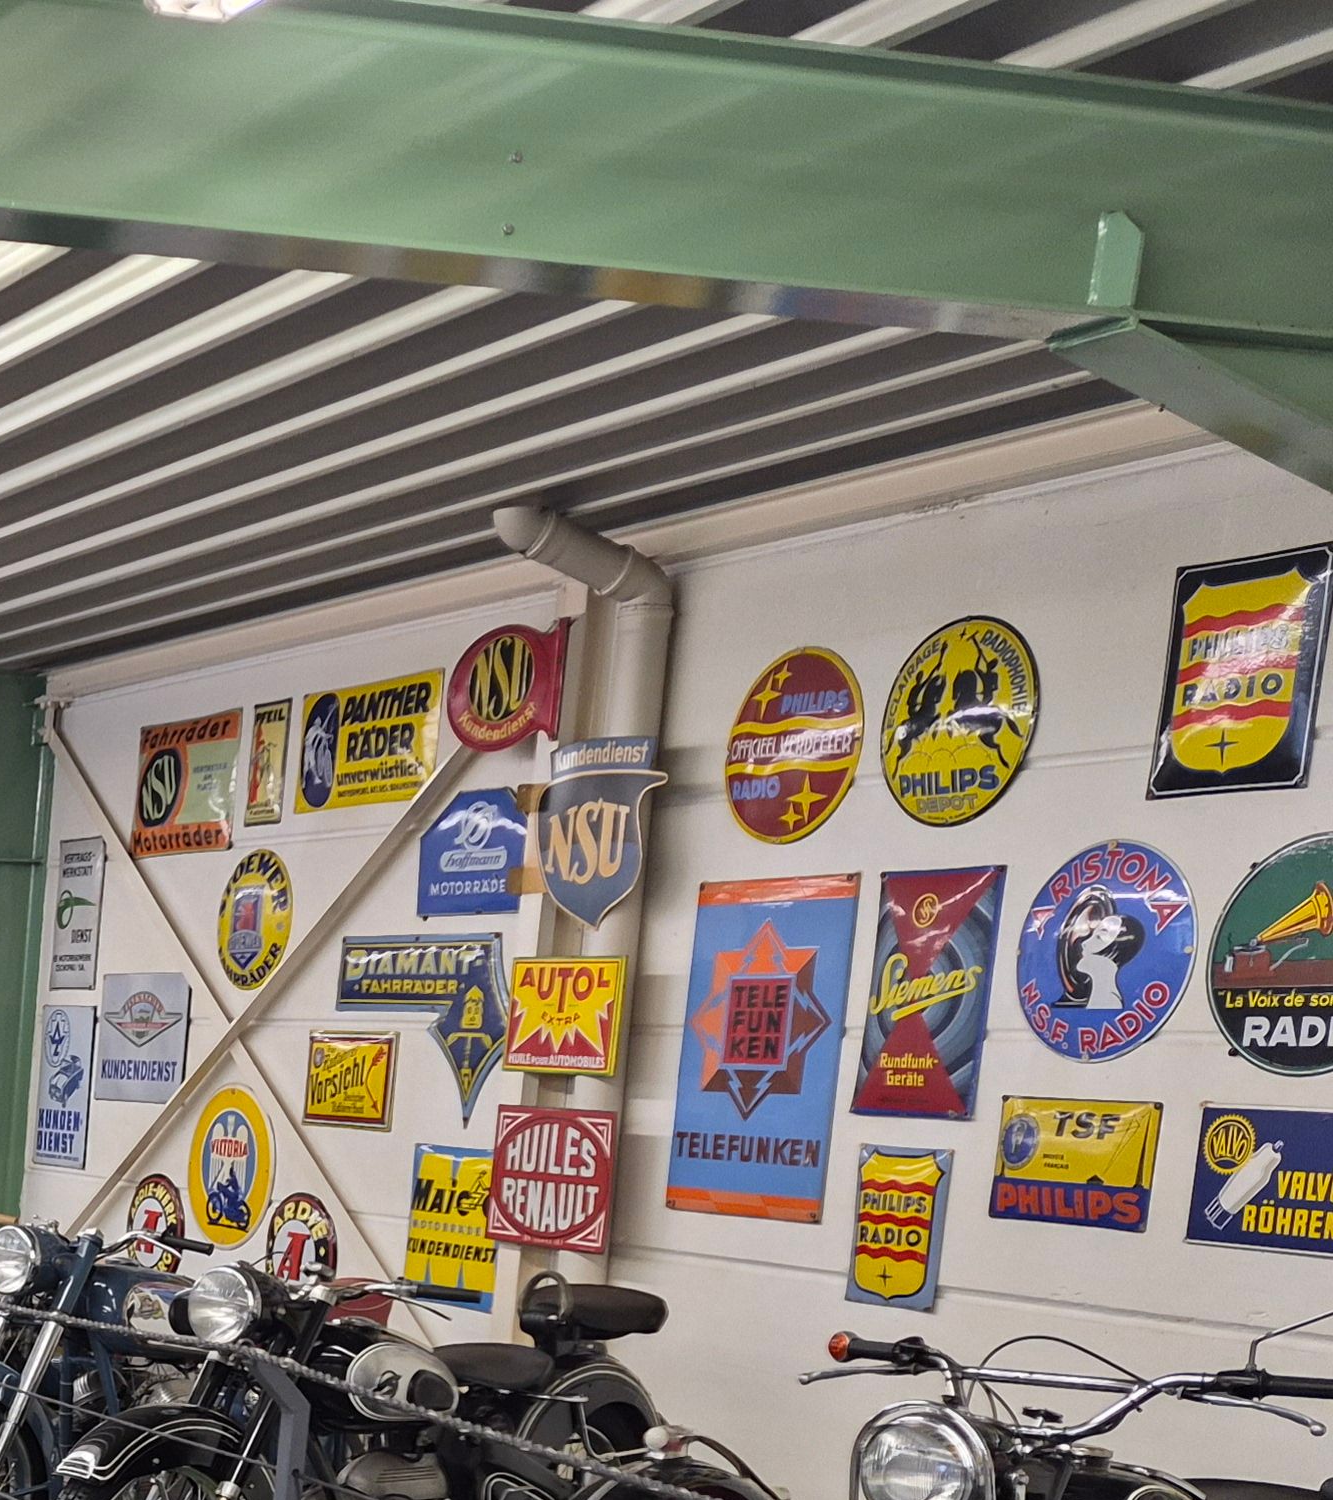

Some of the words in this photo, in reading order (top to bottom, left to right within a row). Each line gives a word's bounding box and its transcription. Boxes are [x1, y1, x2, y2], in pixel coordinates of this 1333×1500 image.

[472, 635, 532, 723] NSU
[886, 639, 943, 730] ECLAIRAGE
[1181, 672, 1284, 706] RADIO
[341, 681, 433, 727] PANTHER
[779, 689, 850, 715] PHILIPS
[255, 709, 287, 726] PFEIL
[458, 701, 539, 742] Kundendienst
[143, 718, 231, 750] Fahrräder
[345, 722, 416, 763] RÄDER
[554, 739, 650, 773] Kundendienst
[141, 755, 179, 821] NSU
[732, 775, 781, 800] RADIO
[900, 764, 1002, 798] PHILIPS
[915, 794, 979, 815] DEPOT
[133, 827, 223, 852] Motorräder
[544, 797, 630, 885] NSU
[444, 851, 502, 869] hoffmann
[429, 876, 506, 896] MOTORRÄDE
[1030, 848, 1189, 941] ARISTONA
[519, 966, 611, 1014] AUTOL
[733, 983, 789, 1009] TELE
[869, 952, 984, 1016] Siemens
[1248, 990, 1279, 1009] Voix
[1283, 987, 1305, 1008] de
[540, 1010, 582, 1027] EXTRA
[731, 1010, 784, 1035] FUN
[1078, 980, 1172, 1056] RADIO
[508, 1051, 531, 1066] HUILE
[549, 1053, 606, 1069] AUTOMOBILES
[729, 1035, 780, 1060] KEN
[879, 1052, 940, 1071] Rundfunk-
[100, 1058, 178, 1083] KUNDENDIENST
[885, 1068, 926, 1088] Geräte
[37, 1108, 83, 1132] KUNDEN-
[1053, 1110, 1122, 1139] TSF
[36, 1130, 75, 1154] DIENST
[211, 1137, 249, 1158] VICTORIA
[505, 1121, 597, 1179] HUILES
[675, 1131, 822, 1168] TELEFUNKEN
[1212, 1124, 1249, 1161] VALVO
[1277, 1170, 1333, 1203] VALV
[501, 1177, 600, 1234] RENAULT
[861, 1190, 928, 1215] PHILIPS
[995, 1182, 1142, 1226] PHILIPS
[859, 1223, 922, 1248] RADIO
[406, 1237, 497, 1265] KUNDENDIENST
